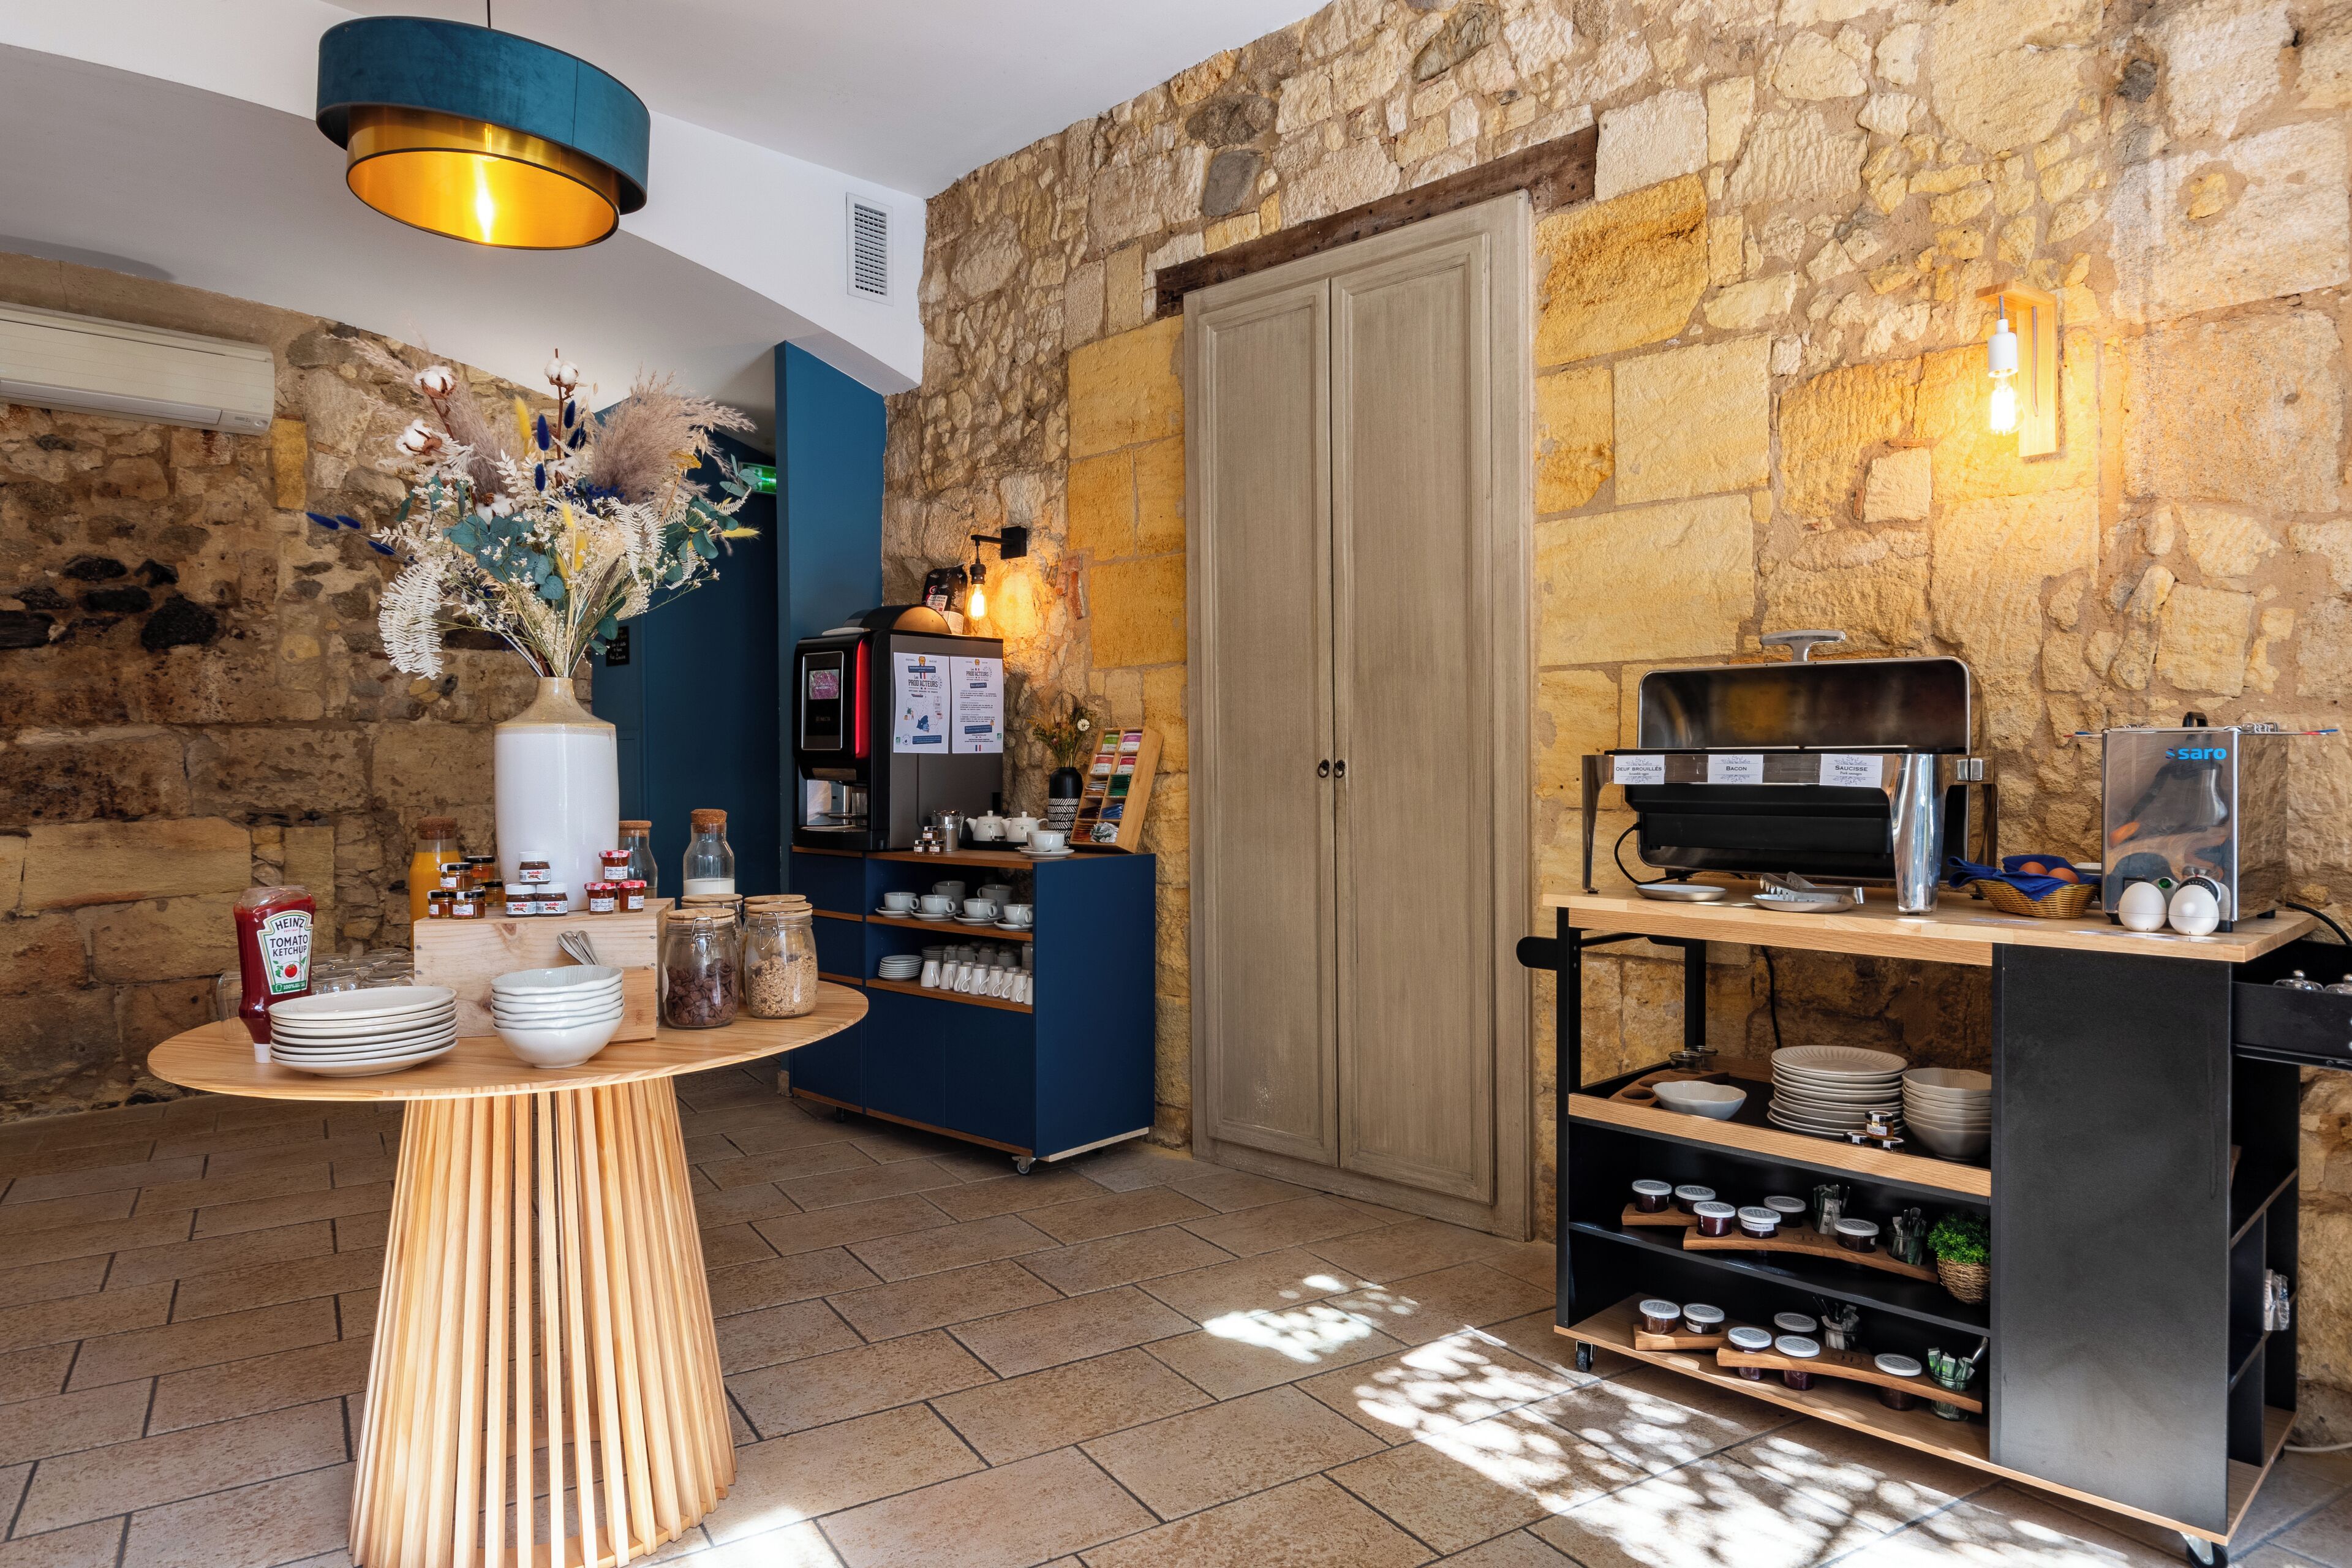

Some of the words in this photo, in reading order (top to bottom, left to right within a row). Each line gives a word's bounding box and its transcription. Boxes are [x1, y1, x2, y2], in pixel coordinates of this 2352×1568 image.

[2178, 748, 2227, 760] saro
[275, 918, 305, 931] HEINZ
[270, 934, 308, 948] TOMATO
[273, 945, 307, 957] KETCHUP
